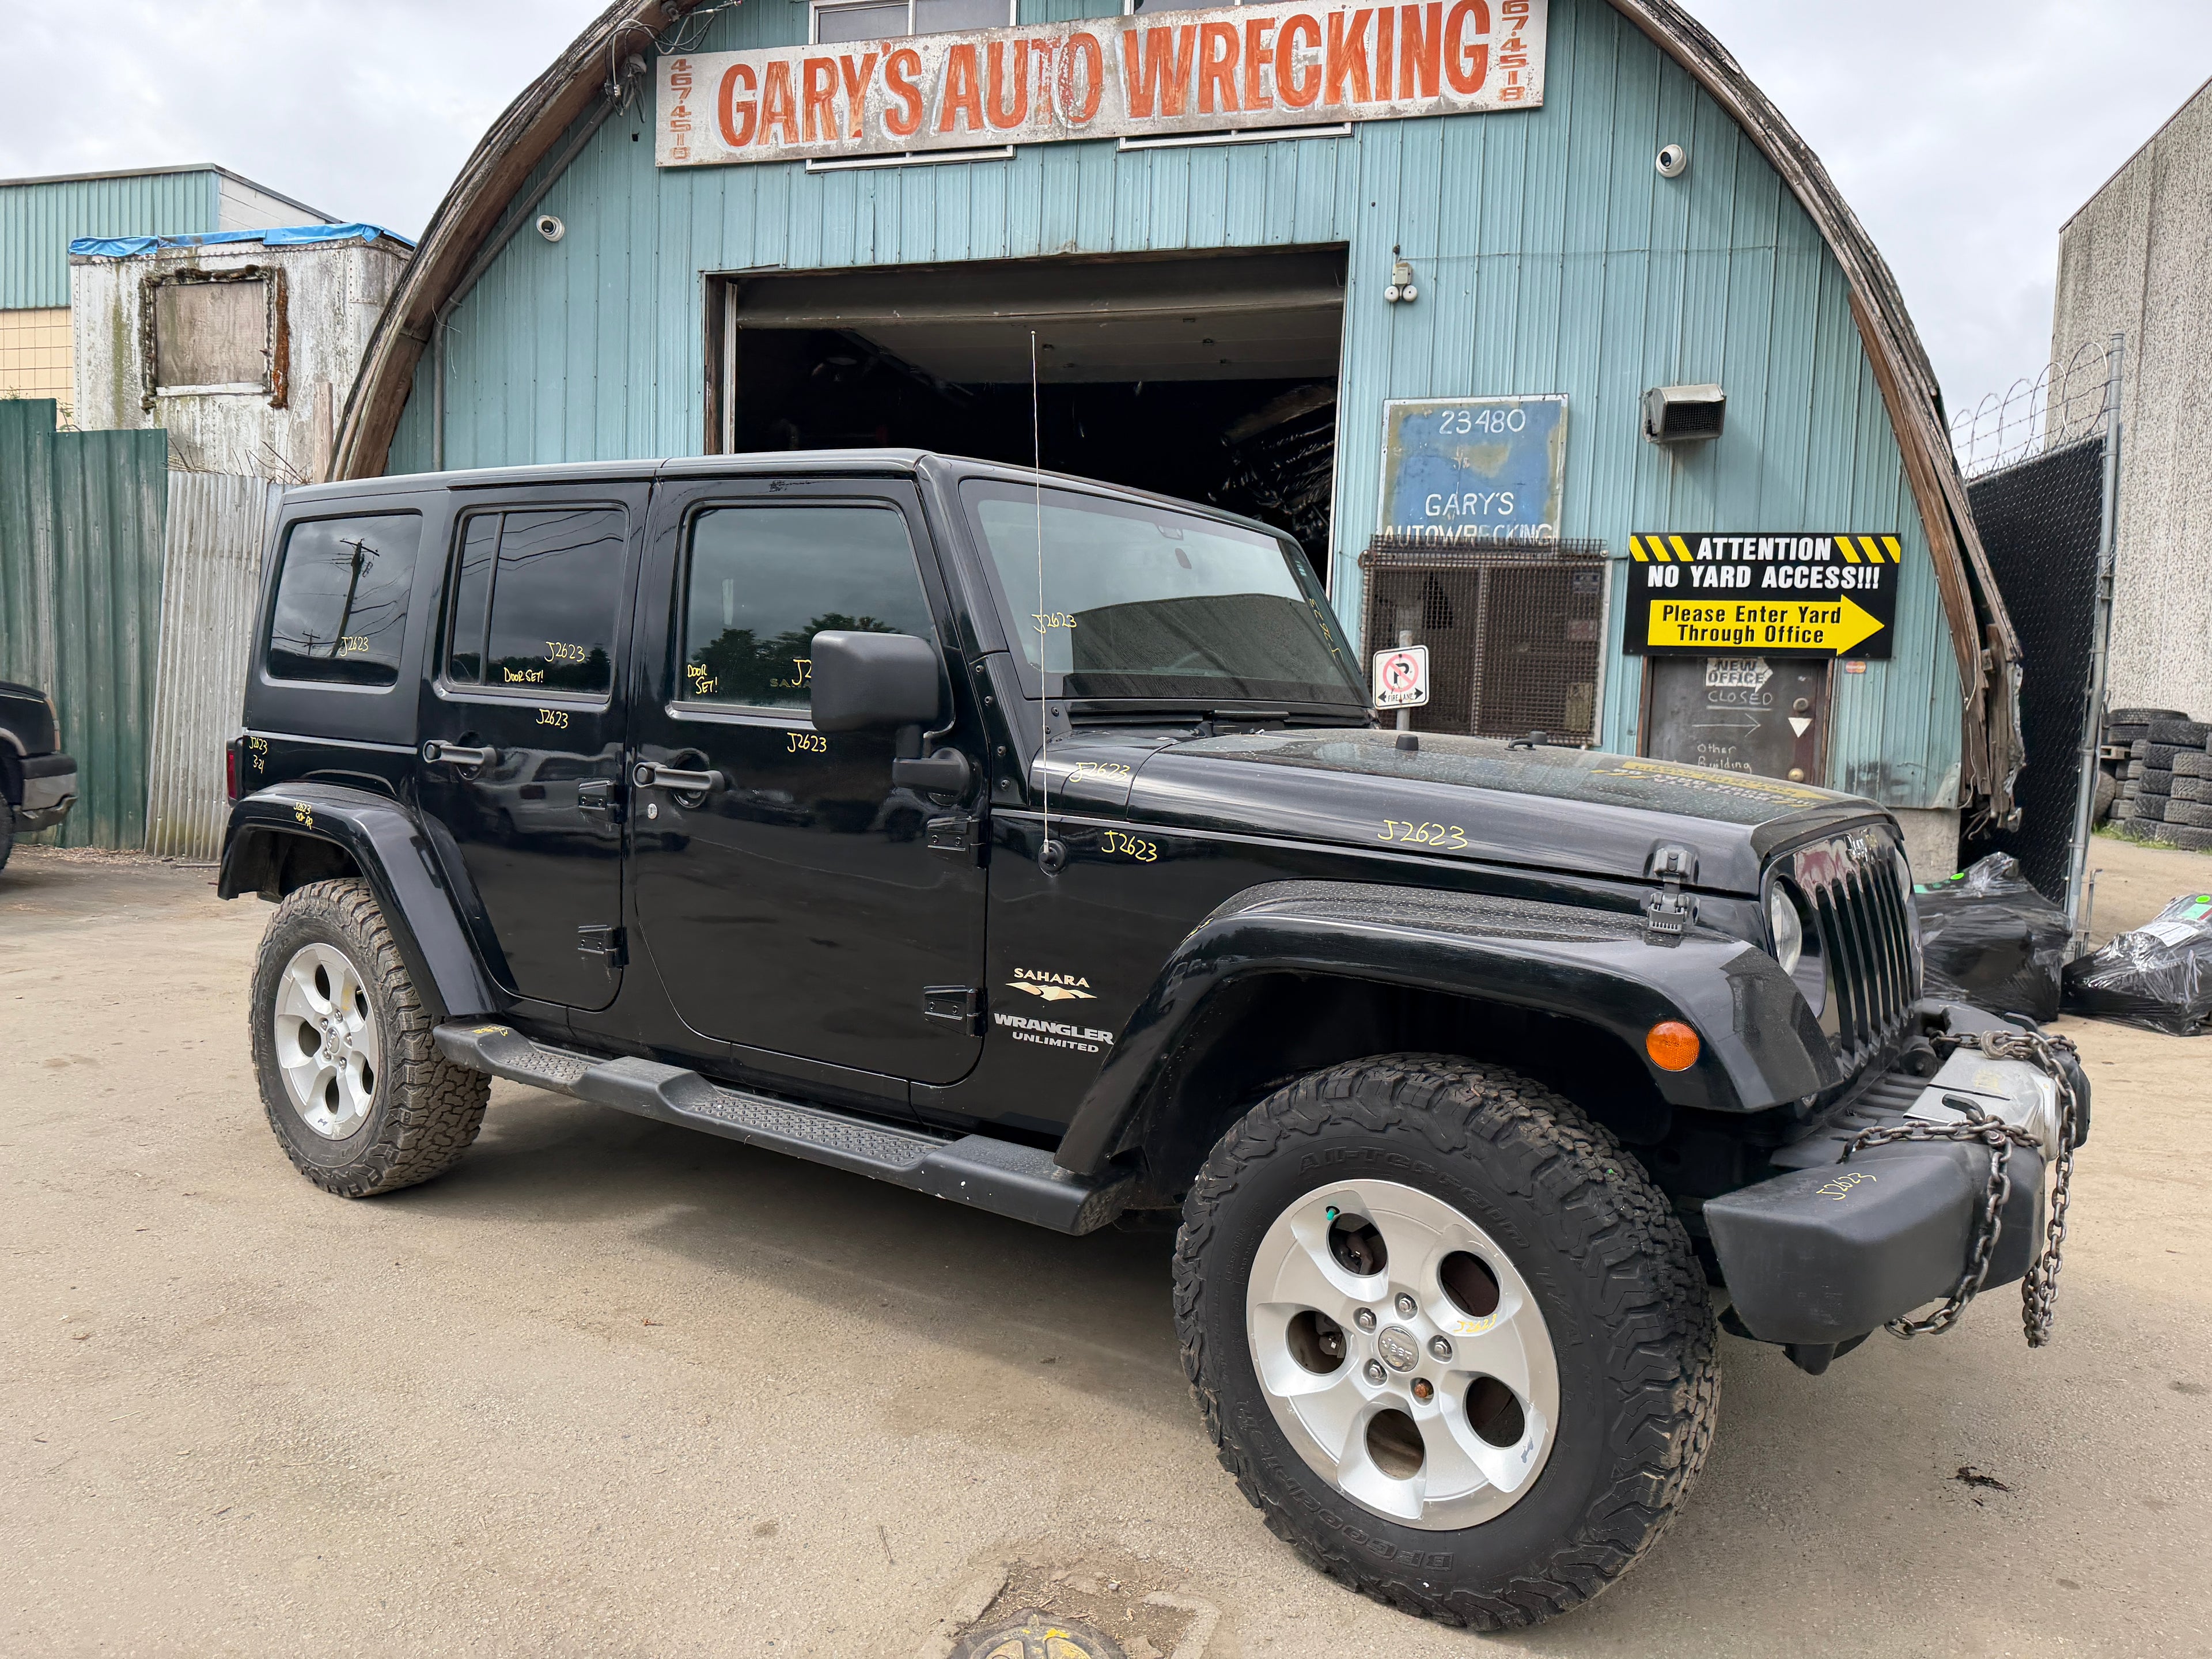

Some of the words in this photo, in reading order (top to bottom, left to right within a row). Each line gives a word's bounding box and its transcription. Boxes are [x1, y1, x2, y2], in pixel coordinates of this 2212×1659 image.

[714, 42, 922, 149] GARY'S
[934, 32, 1103, 133] AUTO
[1120, 0, 1491, 119] WRECKING
[1440, 408, 1526, 434] 23480
[1425, 492, 1514, 517] GARY'S
[1696, 537, 1832, 561] ATTENTION
[1647, 565, 1679, 588] NO
[1690, 566, 1751, 589] YARD
[1762, 566, 1880, 590] ACCESS!!!
[1031, 611, 1077, 634] J2623
[1662, 605, 1725, 623] Please
[1736, 605, 1788, 623] Enter
[1798, 606, 1841, 624] Yard
[1677, 625, 1755, 645] Through
[1765, 626, 1824, 643] Office
[339, 637, 369, 657] J2623
[544, 641, 586, 662] J2623
[1717, 659, 1756, 672] NEW
[1708, 671, 1764, 684] OFFICE
[1708, 690, 1772, 705] CLOSED
[536, 708, 569, 729] J2623
[249, 736, 267, 755] J2623
[787, 732, 827, 753] J2623
[1697, 743, 1737, 755] Other
[1068, 762, 1131, 783] J2623
[293, 801, 312, 815] J2623
[1377, 818, 1468, 850] J2623
[1101, 830, 1158, 863] J2623
[1013, 967, 1090, 988] SAHARA
[993, 1013, 1115, 1046] WRANGLER
[1012, 1031, 1100, 1053] UNLIMITED
[1815, 1172, 1877, 1200] J2623
